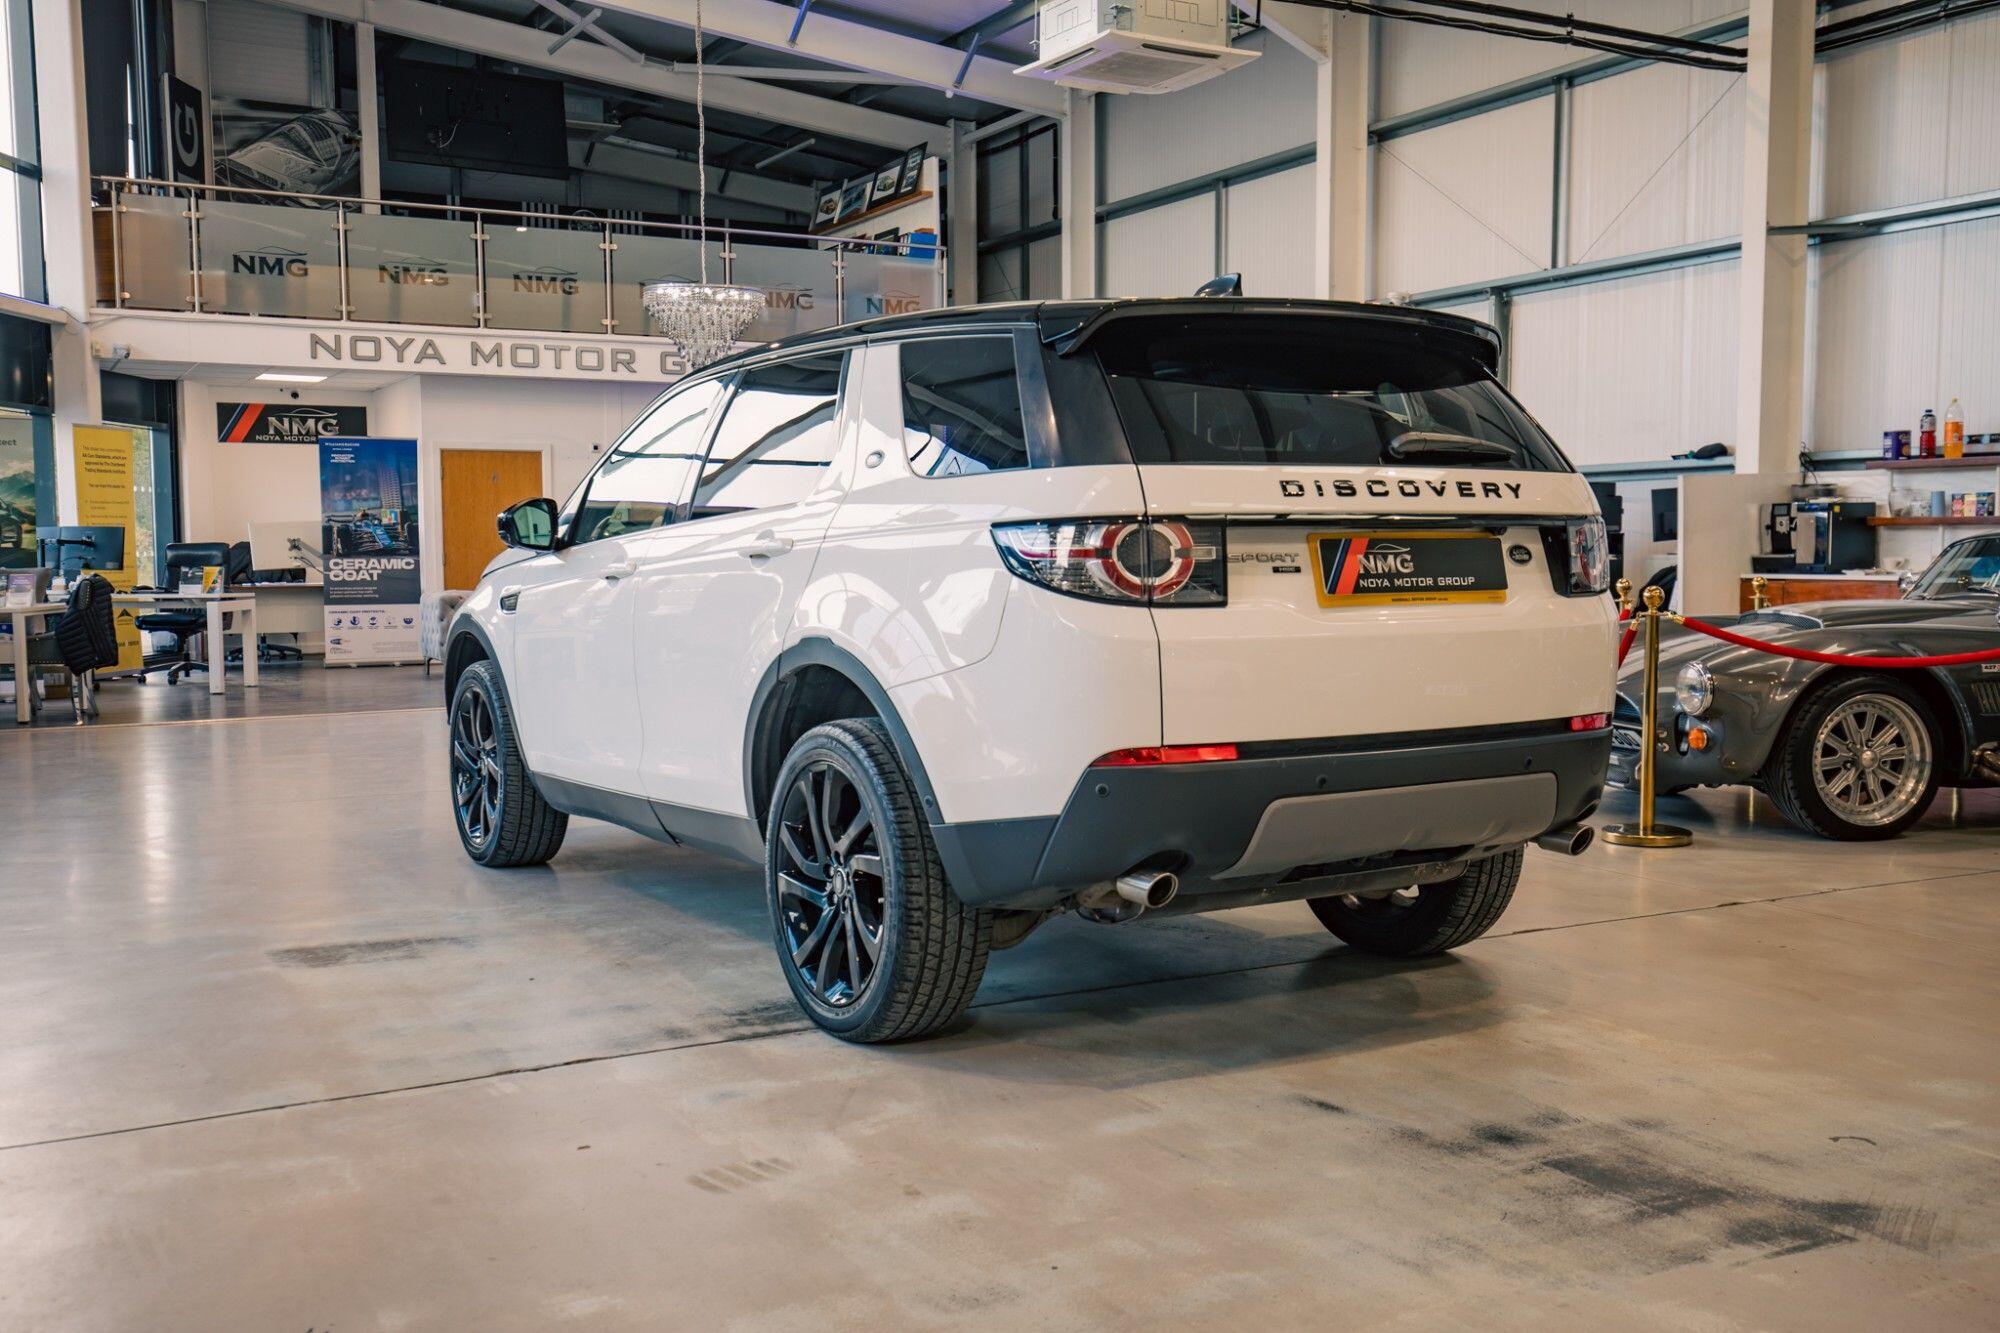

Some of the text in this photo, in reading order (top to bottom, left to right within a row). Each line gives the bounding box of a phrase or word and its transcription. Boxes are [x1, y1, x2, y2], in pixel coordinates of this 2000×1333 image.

[232, 253, 308, 277] NMG
[378, 264, 449, 286] NMG
[513, 274, 579, 296] NMG
[866, 297, 921, 315] NMG
[310, 332, 447, 365] NOYA
[470, 341, 637, 373] MOTOR
[267, 416, 340, 436] NMG
[1279, 480, 1521, 499] DISCOVERY
[329, 558, 415, 570] CERAMIC
[1227, 553, 1300, 563] SPORT
[1358, 554, 1414, 574] NMG
[329, 569, 382, 581] COAT
[1359, 576, 1475, 588] NOYA MOTOR GROUP
